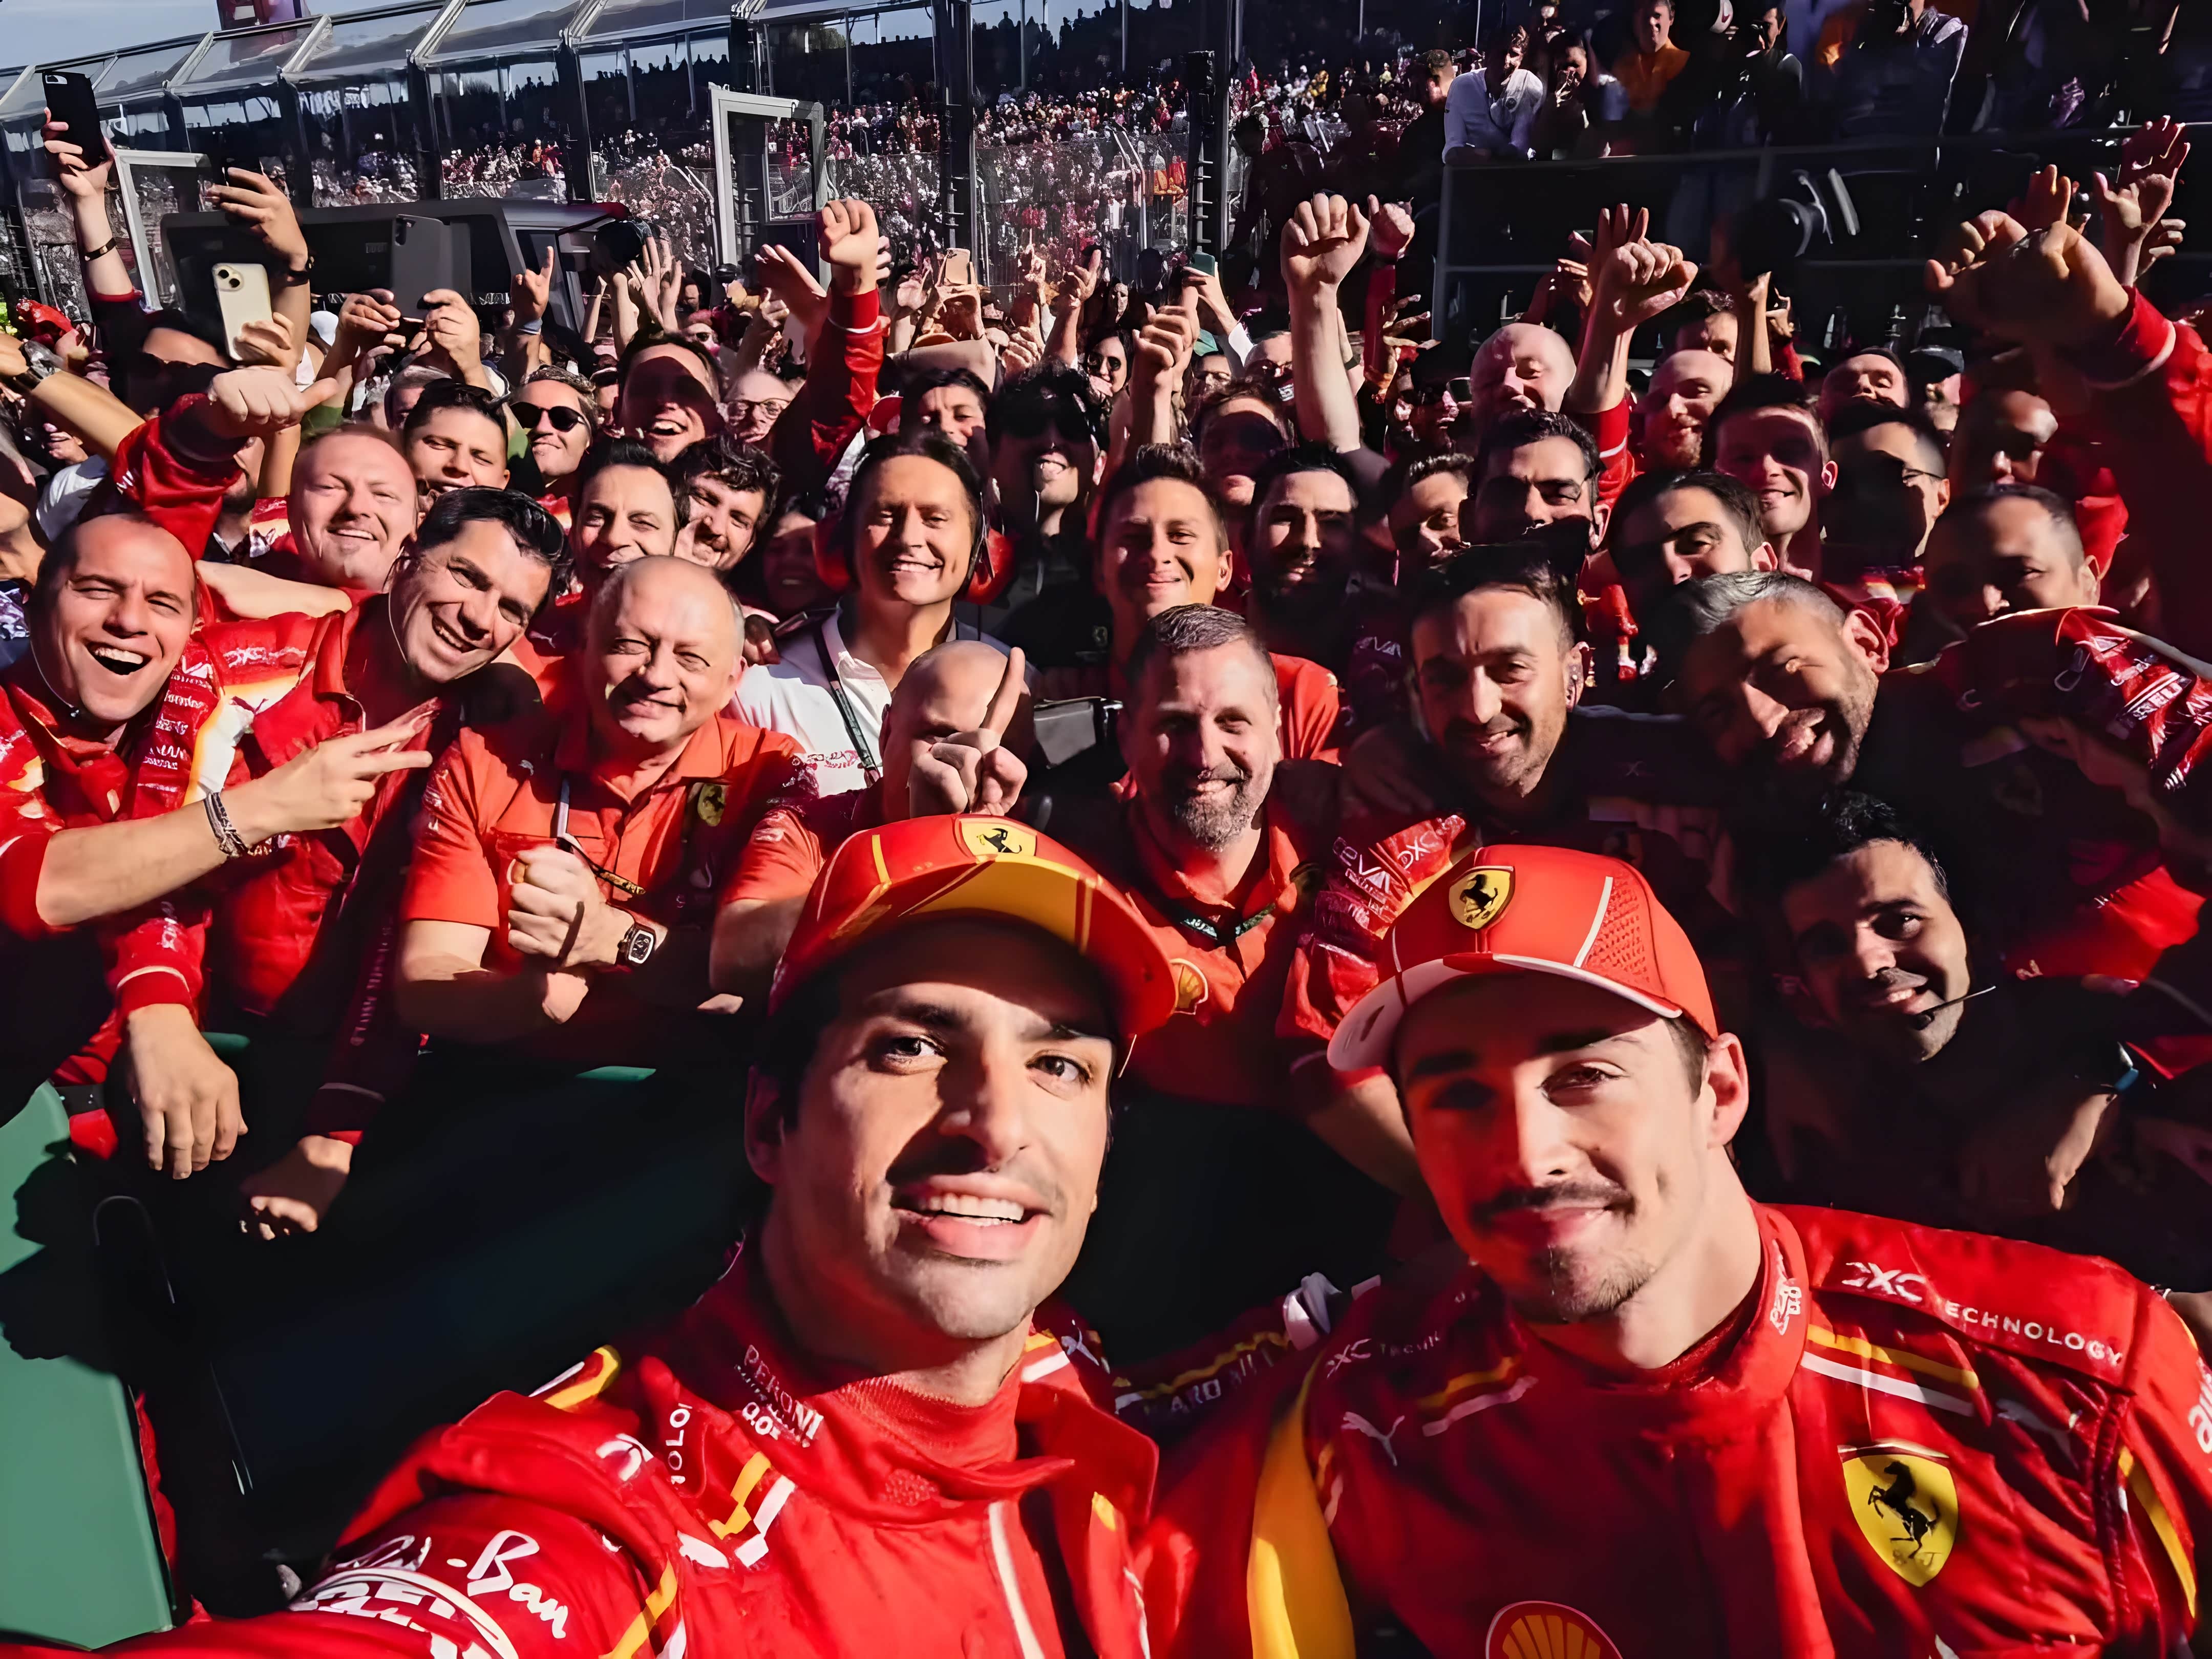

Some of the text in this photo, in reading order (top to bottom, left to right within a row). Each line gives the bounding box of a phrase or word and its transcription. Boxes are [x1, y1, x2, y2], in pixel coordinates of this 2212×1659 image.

[1841, 1262, 1928, 1303] DXC
[1944, 1299, 2123, 1367] ECHNOLOGY
[1327, 1338, 1372, 1379] XC
